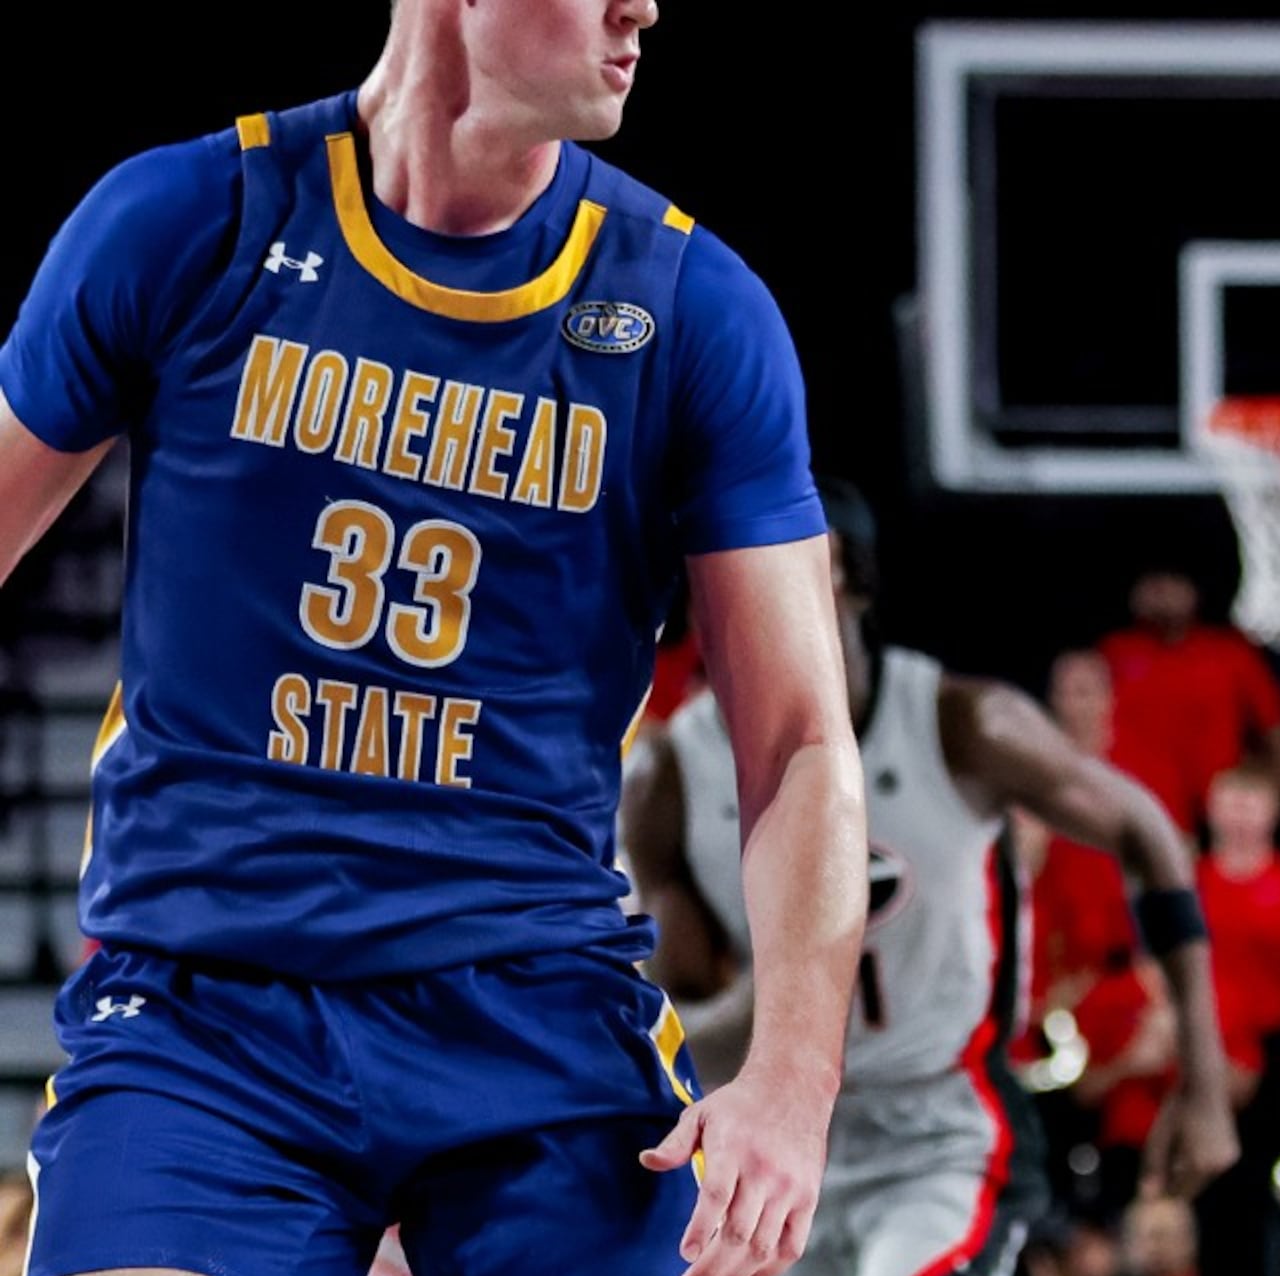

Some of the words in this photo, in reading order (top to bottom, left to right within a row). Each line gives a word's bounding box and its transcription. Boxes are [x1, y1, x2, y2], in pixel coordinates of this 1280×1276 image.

[577, 314, 635, 340] OVC
[230, 333, 608, 514] MOREHEAD
[299, 499, 482, 669] 33
[267, 672, 482, 790] STATE
